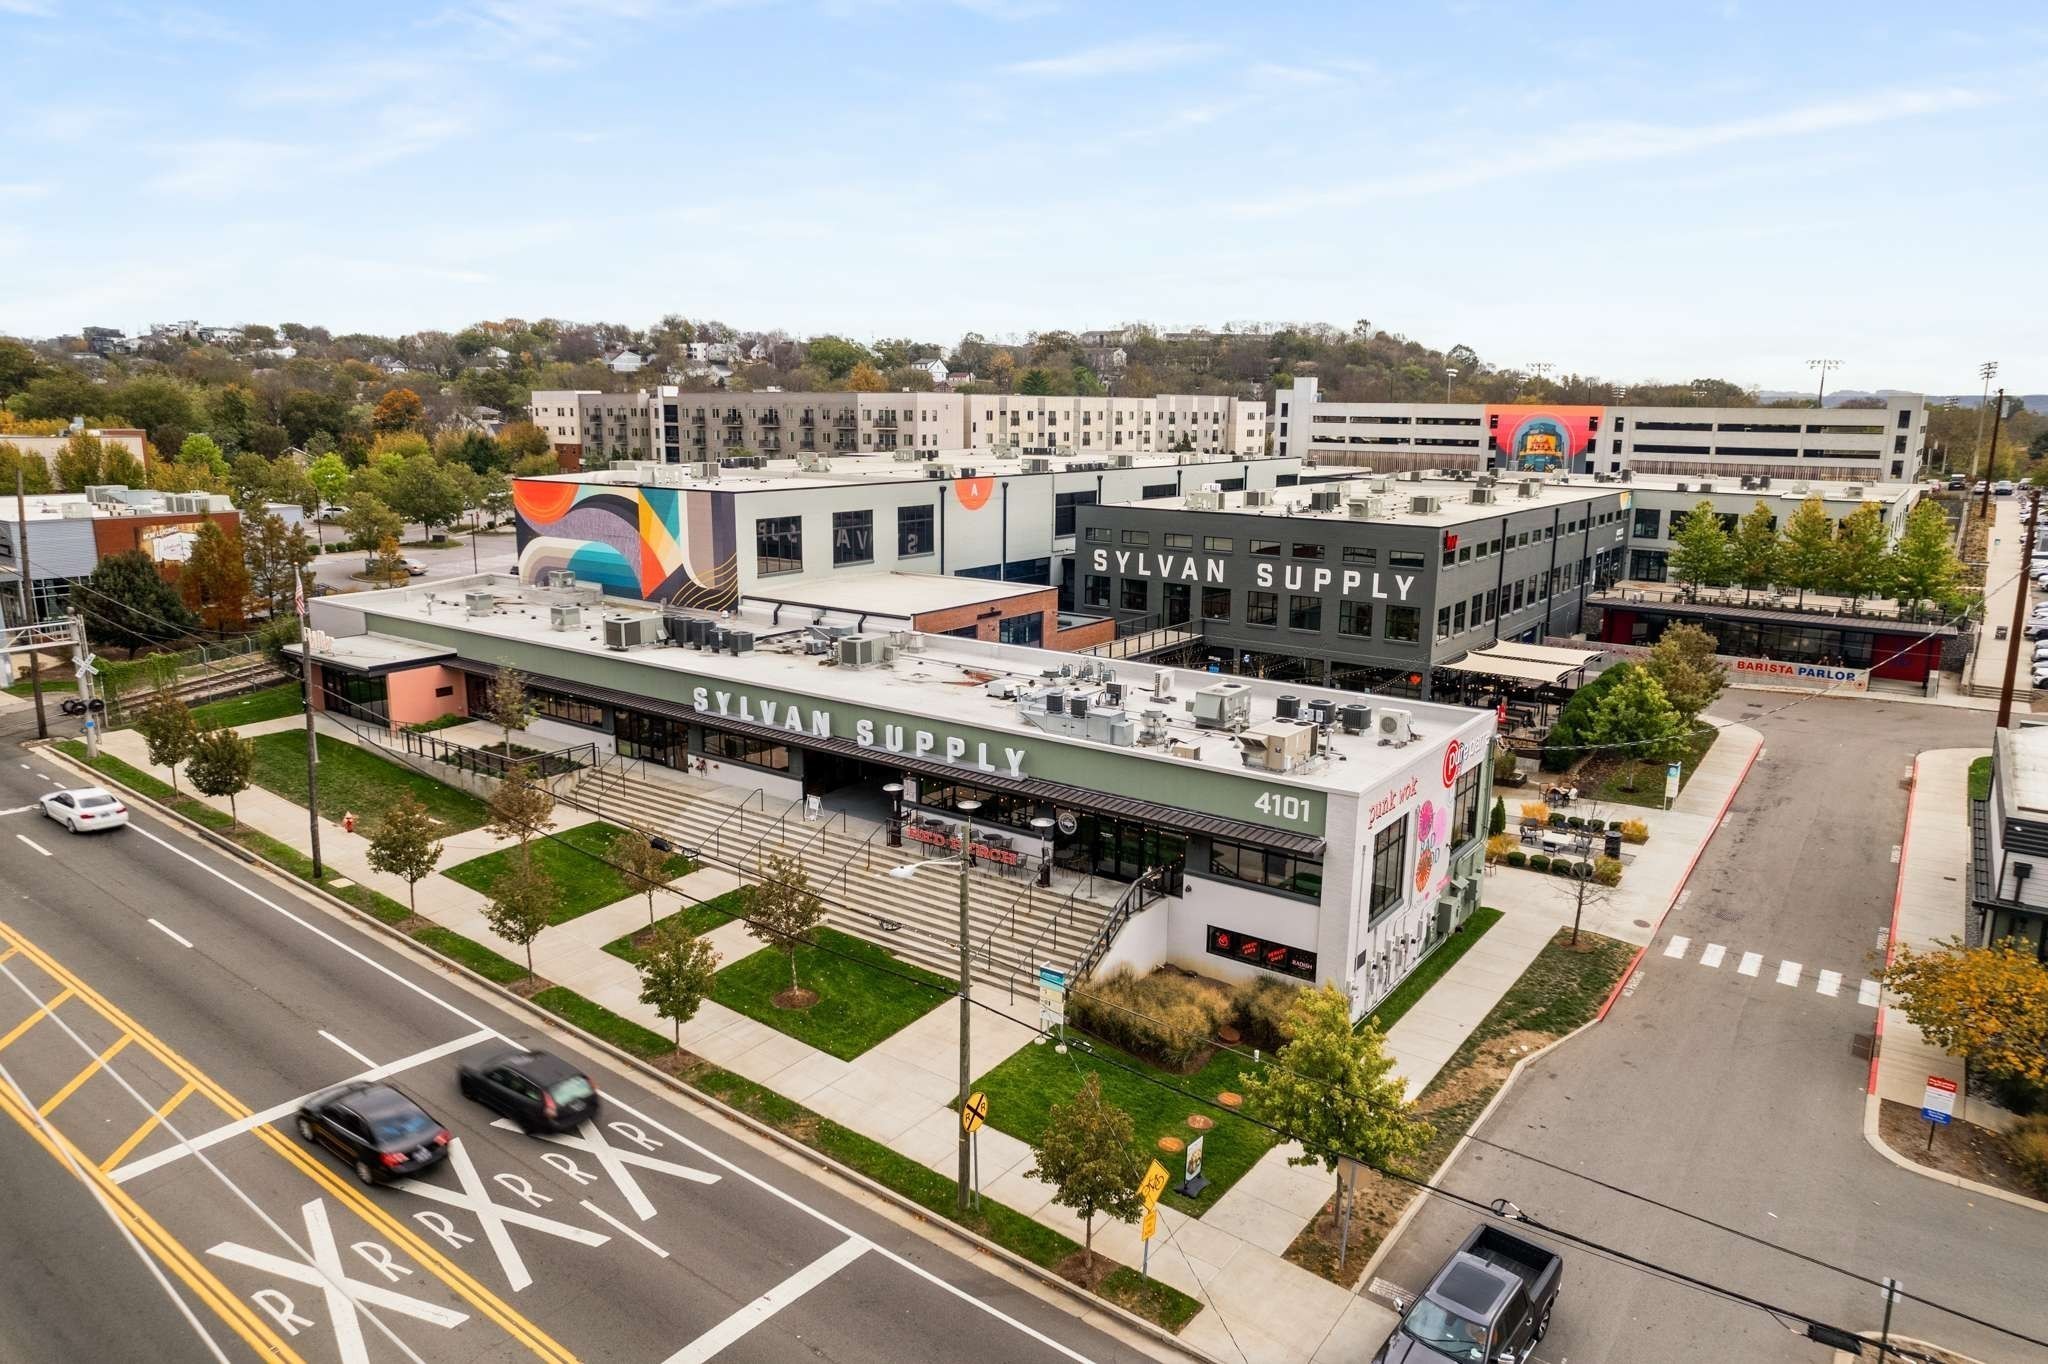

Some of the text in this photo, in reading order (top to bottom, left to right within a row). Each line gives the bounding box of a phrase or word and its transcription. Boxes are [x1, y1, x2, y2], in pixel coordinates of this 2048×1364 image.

[1093, 549, 1415, 601] SYLVAN SUPPLY
[1737, 661, 1856, 682] BARISTA PARLOR
[693, 687, 1026, 777] SYLVAN SUPPLY
[1254, 791, 1310, 822] 4101
